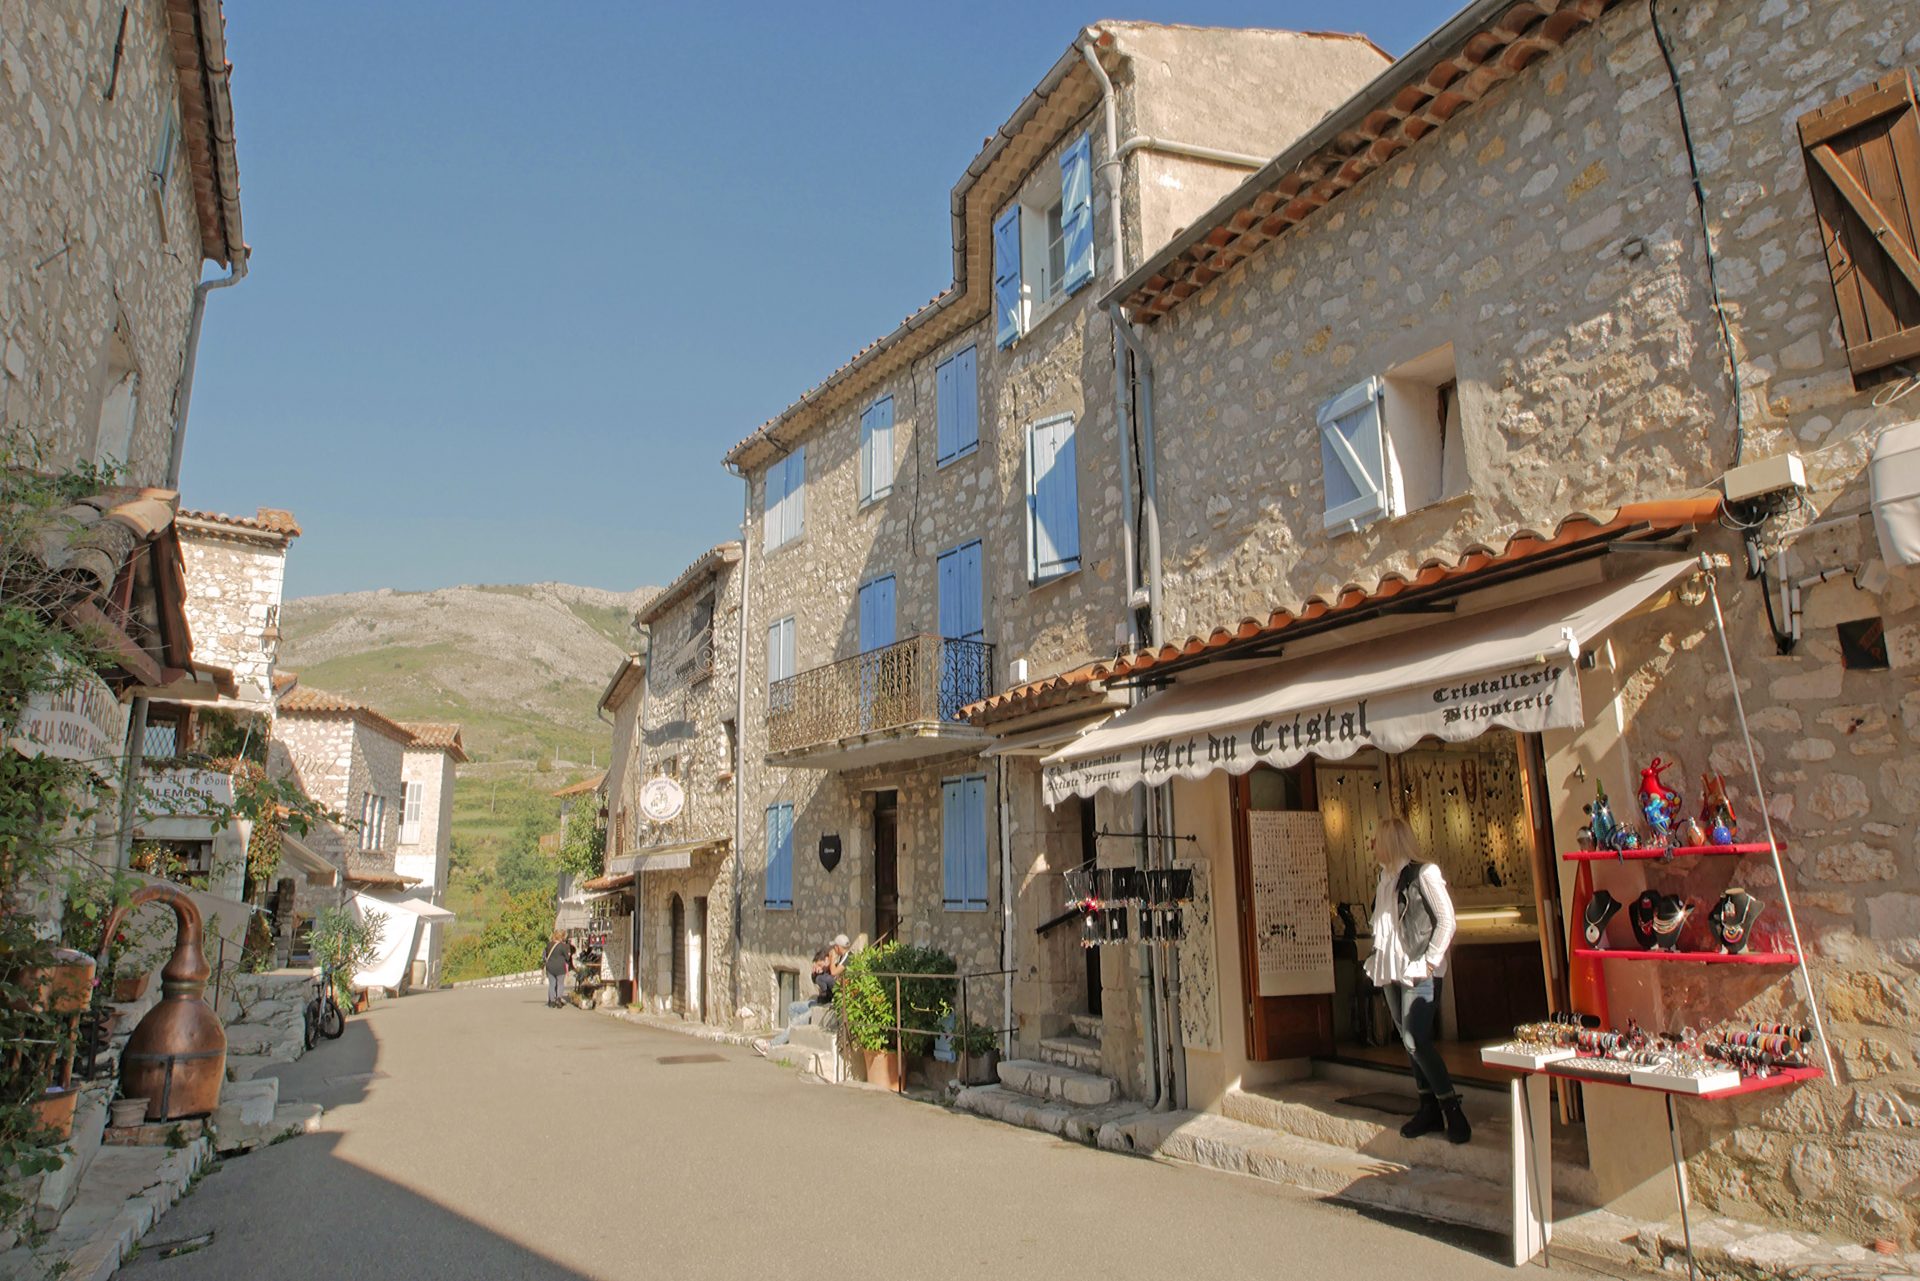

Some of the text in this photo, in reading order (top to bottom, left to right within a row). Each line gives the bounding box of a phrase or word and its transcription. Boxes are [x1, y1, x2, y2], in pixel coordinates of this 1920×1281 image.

[1433, 665, 1563, 703] Cristallerie
[1442, 693, 1553, 726] Bijouterie
[44, 720, 55, 743] LA
[58, 720, 88, 751] SOURCE
[1140, 699, 1371, 774] l'Art du Cristal
[1573, 763, 1585, 783] 4
